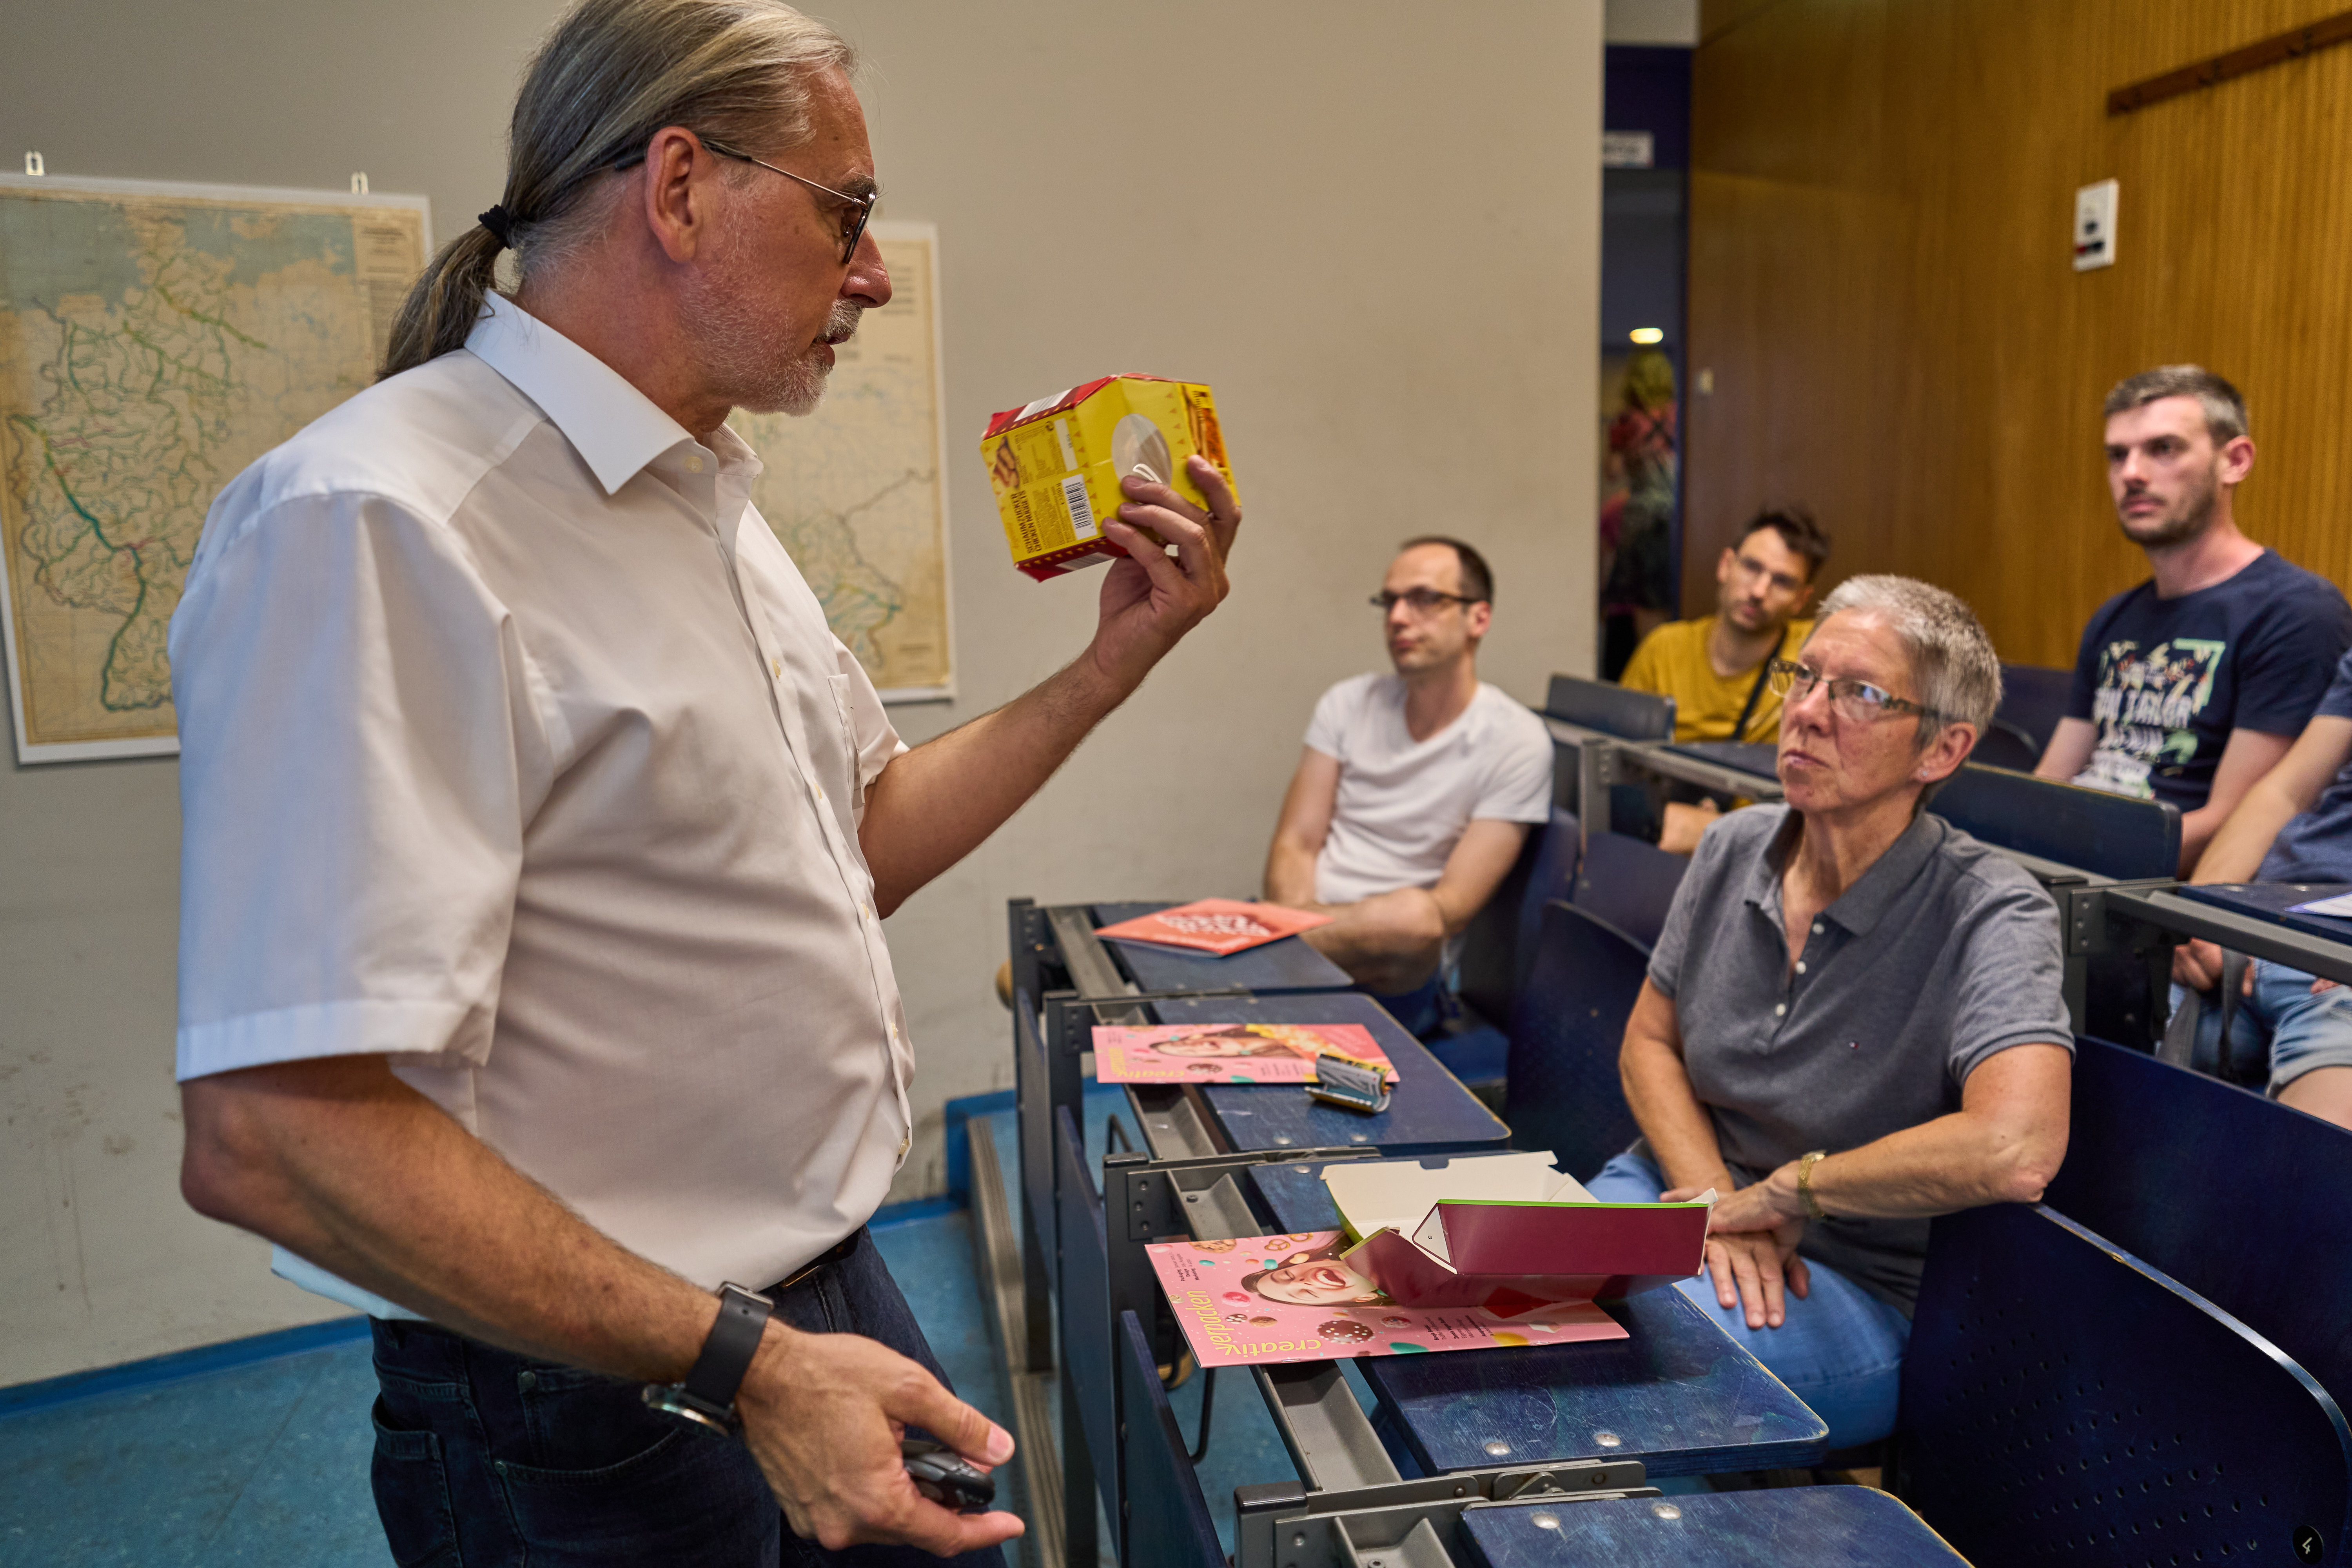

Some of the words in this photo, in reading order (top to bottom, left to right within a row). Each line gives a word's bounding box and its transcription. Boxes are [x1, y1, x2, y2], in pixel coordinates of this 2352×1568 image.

[1018, 490, 1034, 522] NUGGETS
[1027, 523, 1042, 552] CHICKEN
[1177, 1269, 1185, 1281] Packaging
[1191, 1268, 1200, 1280] Marketing
[1186, 1290, 1233, 1350] verpacken
[1225, 1340, 1321, 1357] creativ
[2302, 1537, 2312, 1555] 4
